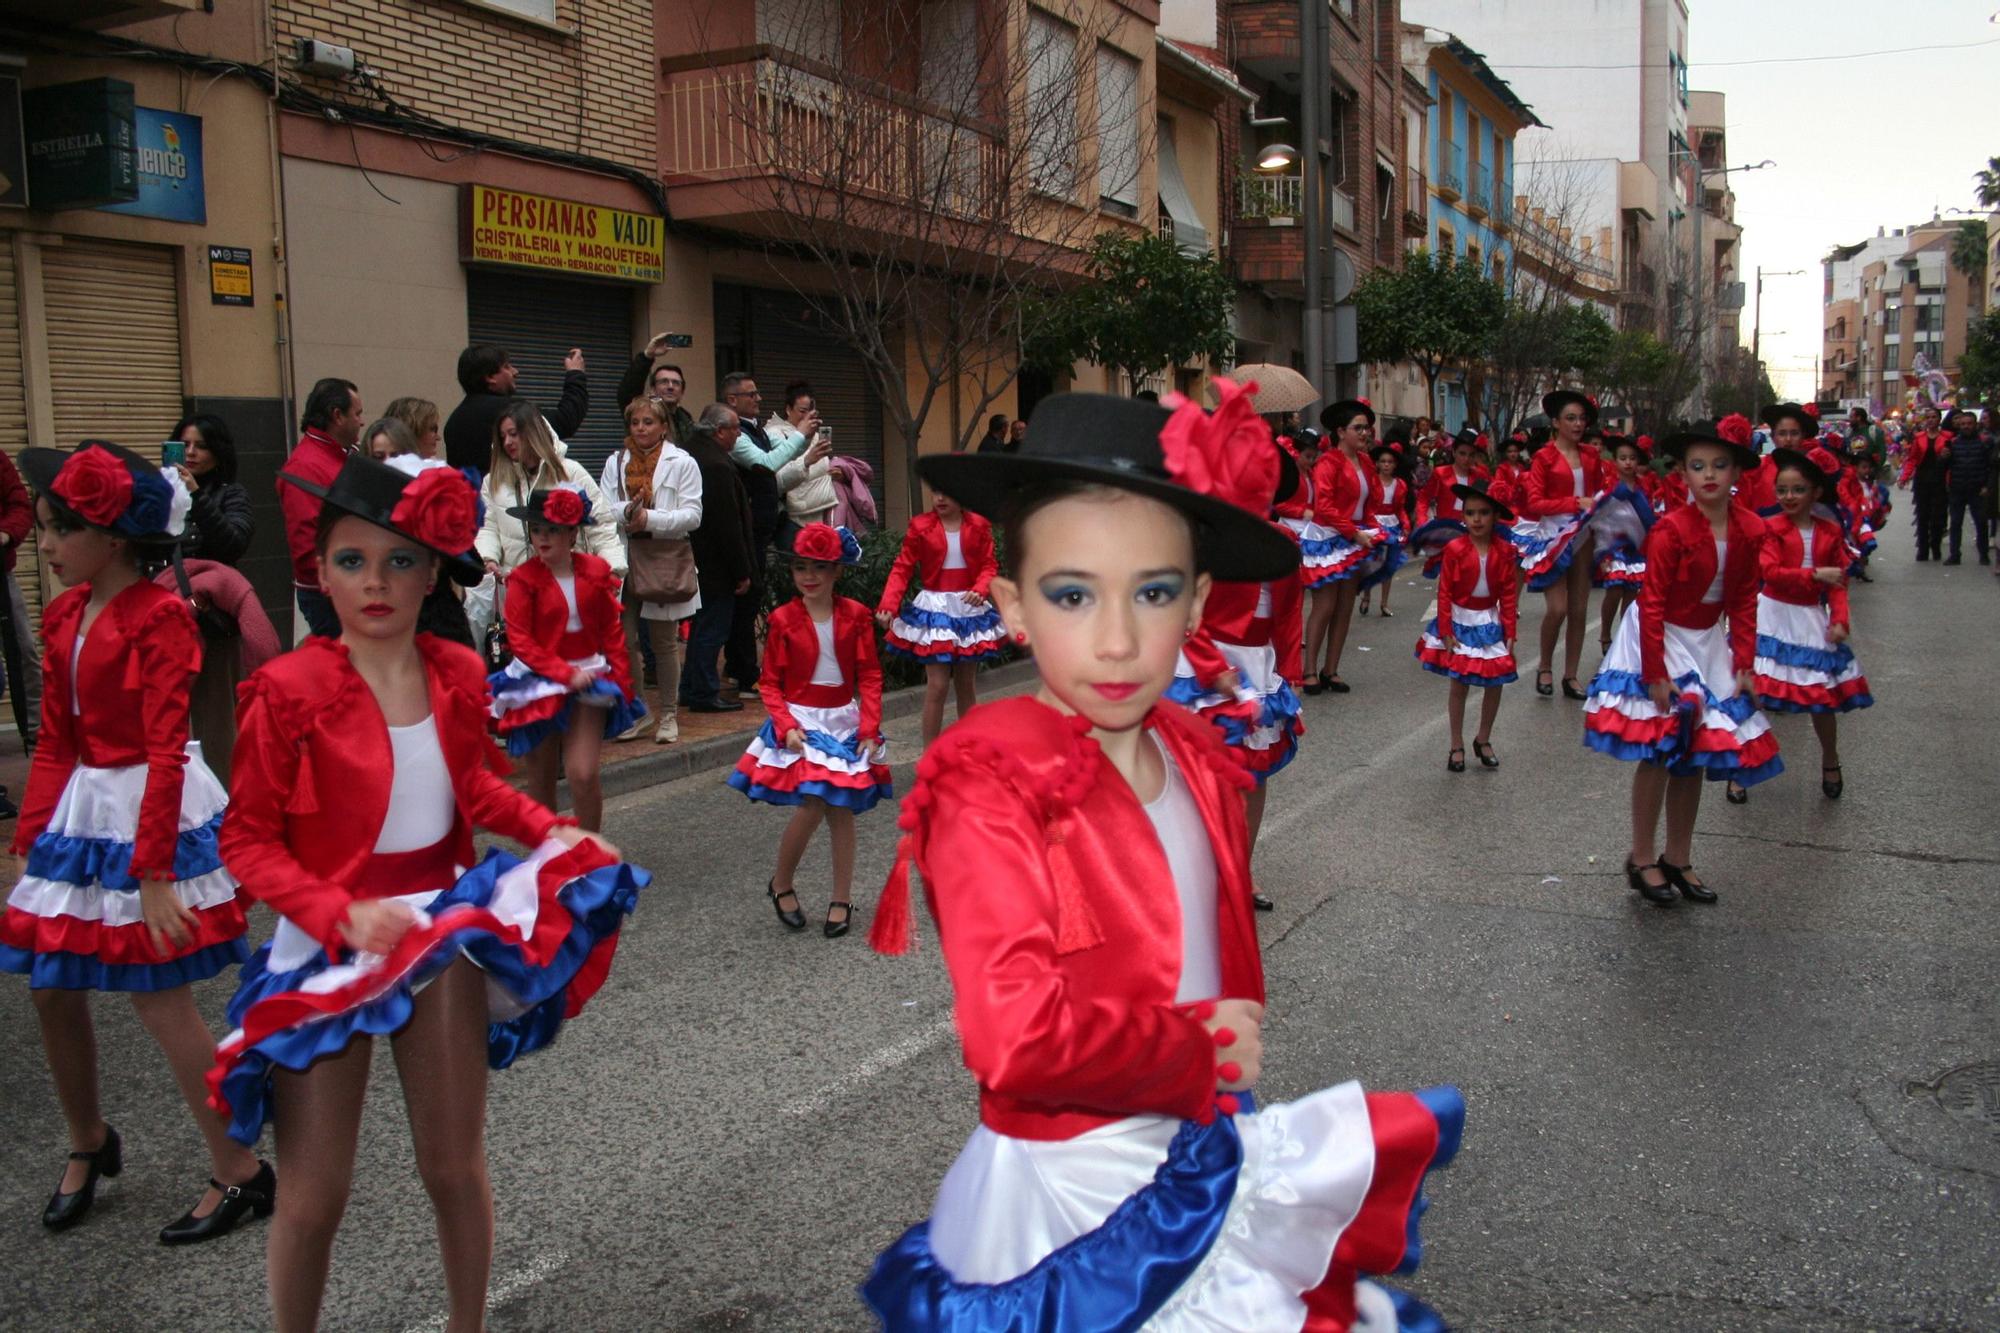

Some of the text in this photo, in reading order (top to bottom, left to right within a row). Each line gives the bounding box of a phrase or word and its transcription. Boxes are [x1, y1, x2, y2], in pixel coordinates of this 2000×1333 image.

[32, 132, 104, 156] ESTRELLA
[483, 190, 655, 248] PERSIANAS VADI
[475, 228, 661, 267] CRISTALERIA Y MARQUETERIA
[567, 259, 617, 275] REPARACION
